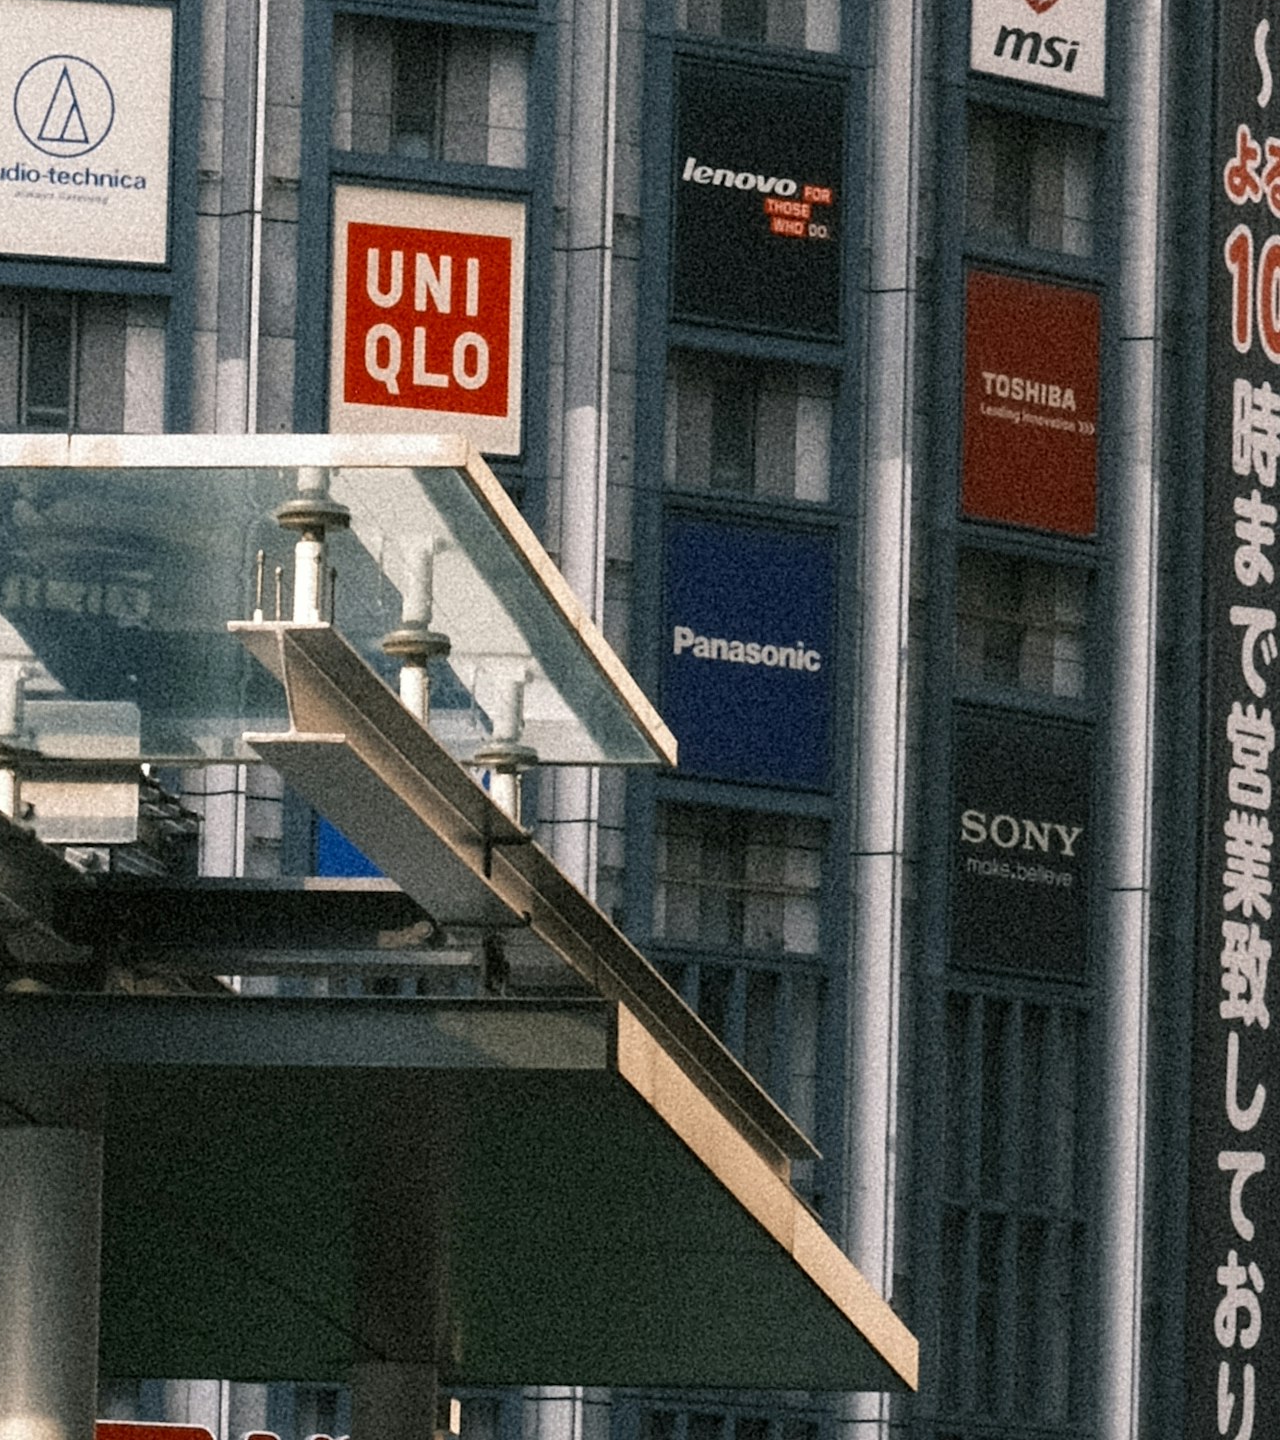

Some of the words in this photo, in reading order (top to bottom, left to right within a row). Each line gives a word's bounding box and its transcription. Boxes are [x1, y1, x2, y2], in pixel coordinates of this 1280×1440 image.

[994, 25, 1079, 72] msi
[682, 157, 797, 196] lenovo
[804, 186, 832, 203] FOR
[766, 198, 811, 218] THOSE
[772, 218, 804, 235] WHO
[364, 247, 480, 318] UNI
[363, 322, 491, 396] QLO
[981, 371, 1077, 412] TOSHIBA
[673, 626, 822, 673] Panasonic
[961, 810, 1084, 857] SONY
